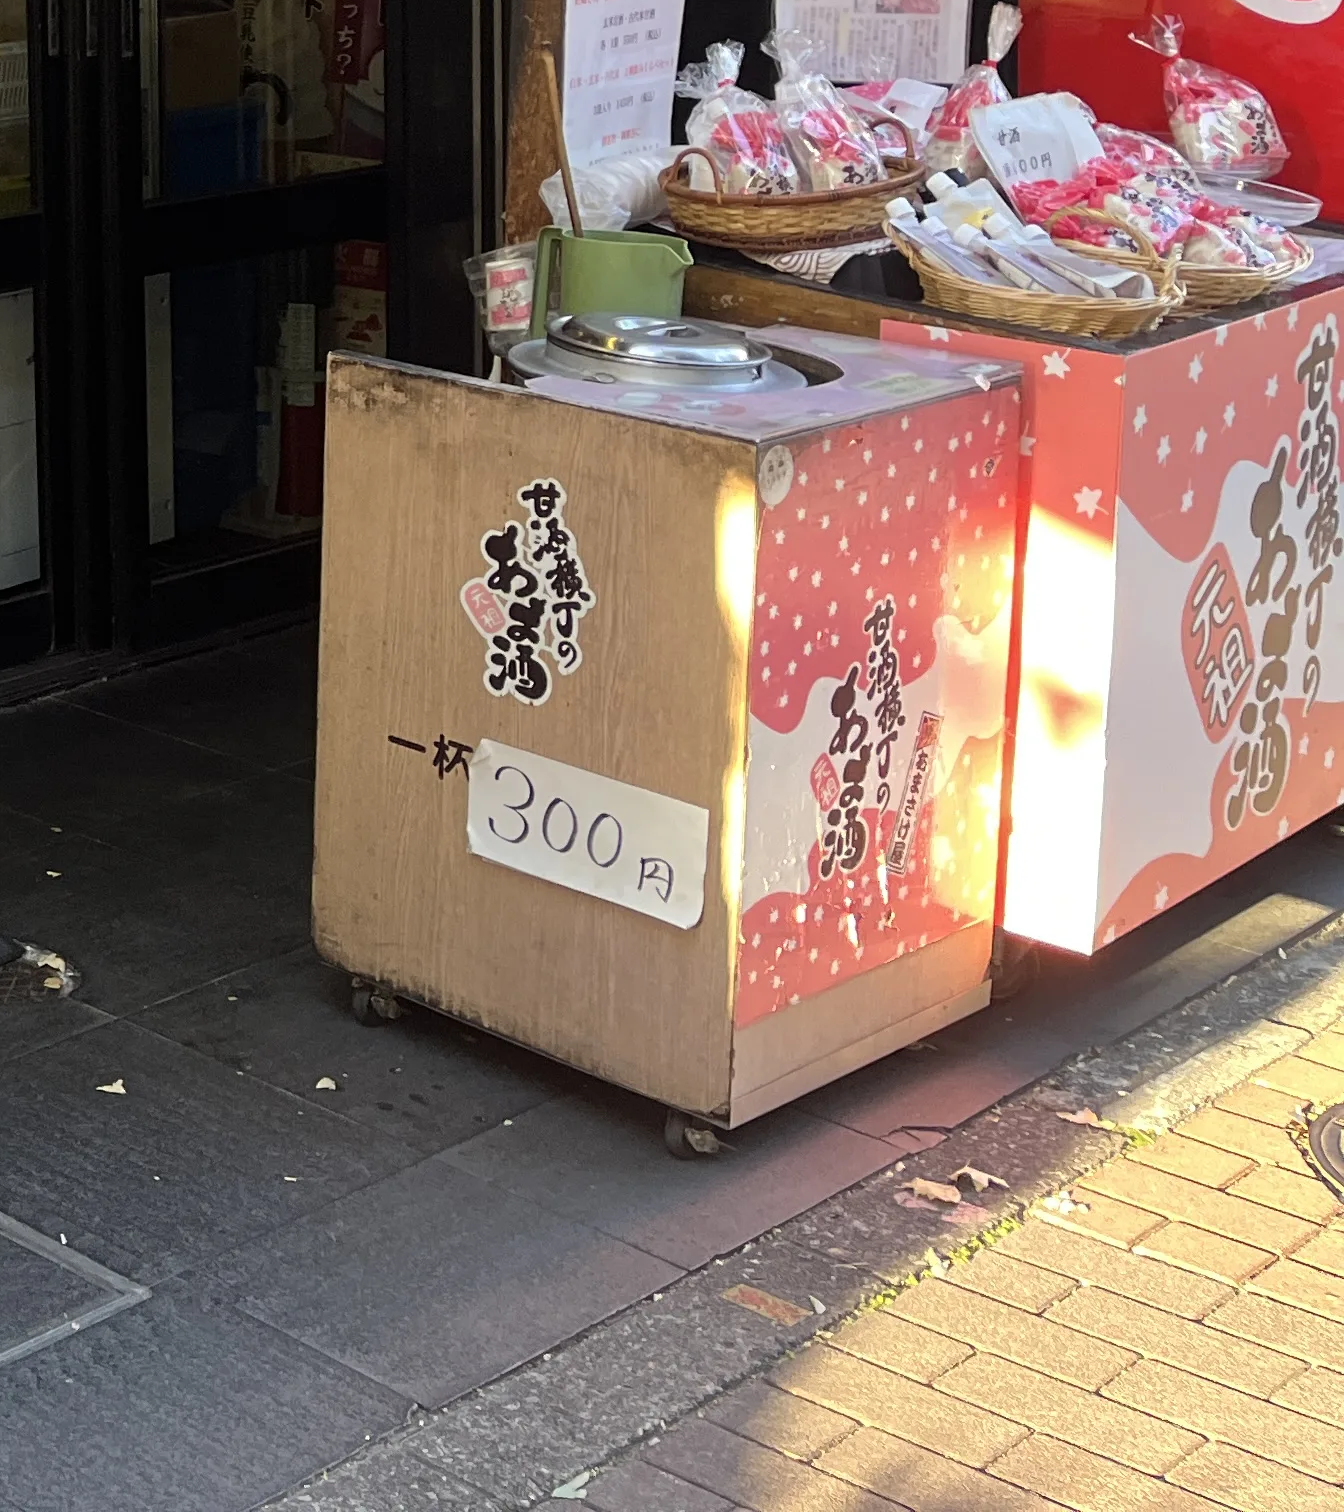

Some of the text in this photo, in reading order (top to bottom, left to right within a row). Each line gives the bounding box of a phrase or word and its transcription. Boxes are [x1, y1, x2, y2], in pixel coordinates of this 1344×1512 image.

[522, 485, 592, 672] 甘酒横丁の
[864, 600, 907, 817] 甘酒横丁の
[487, 764, 675, 904] 300円
